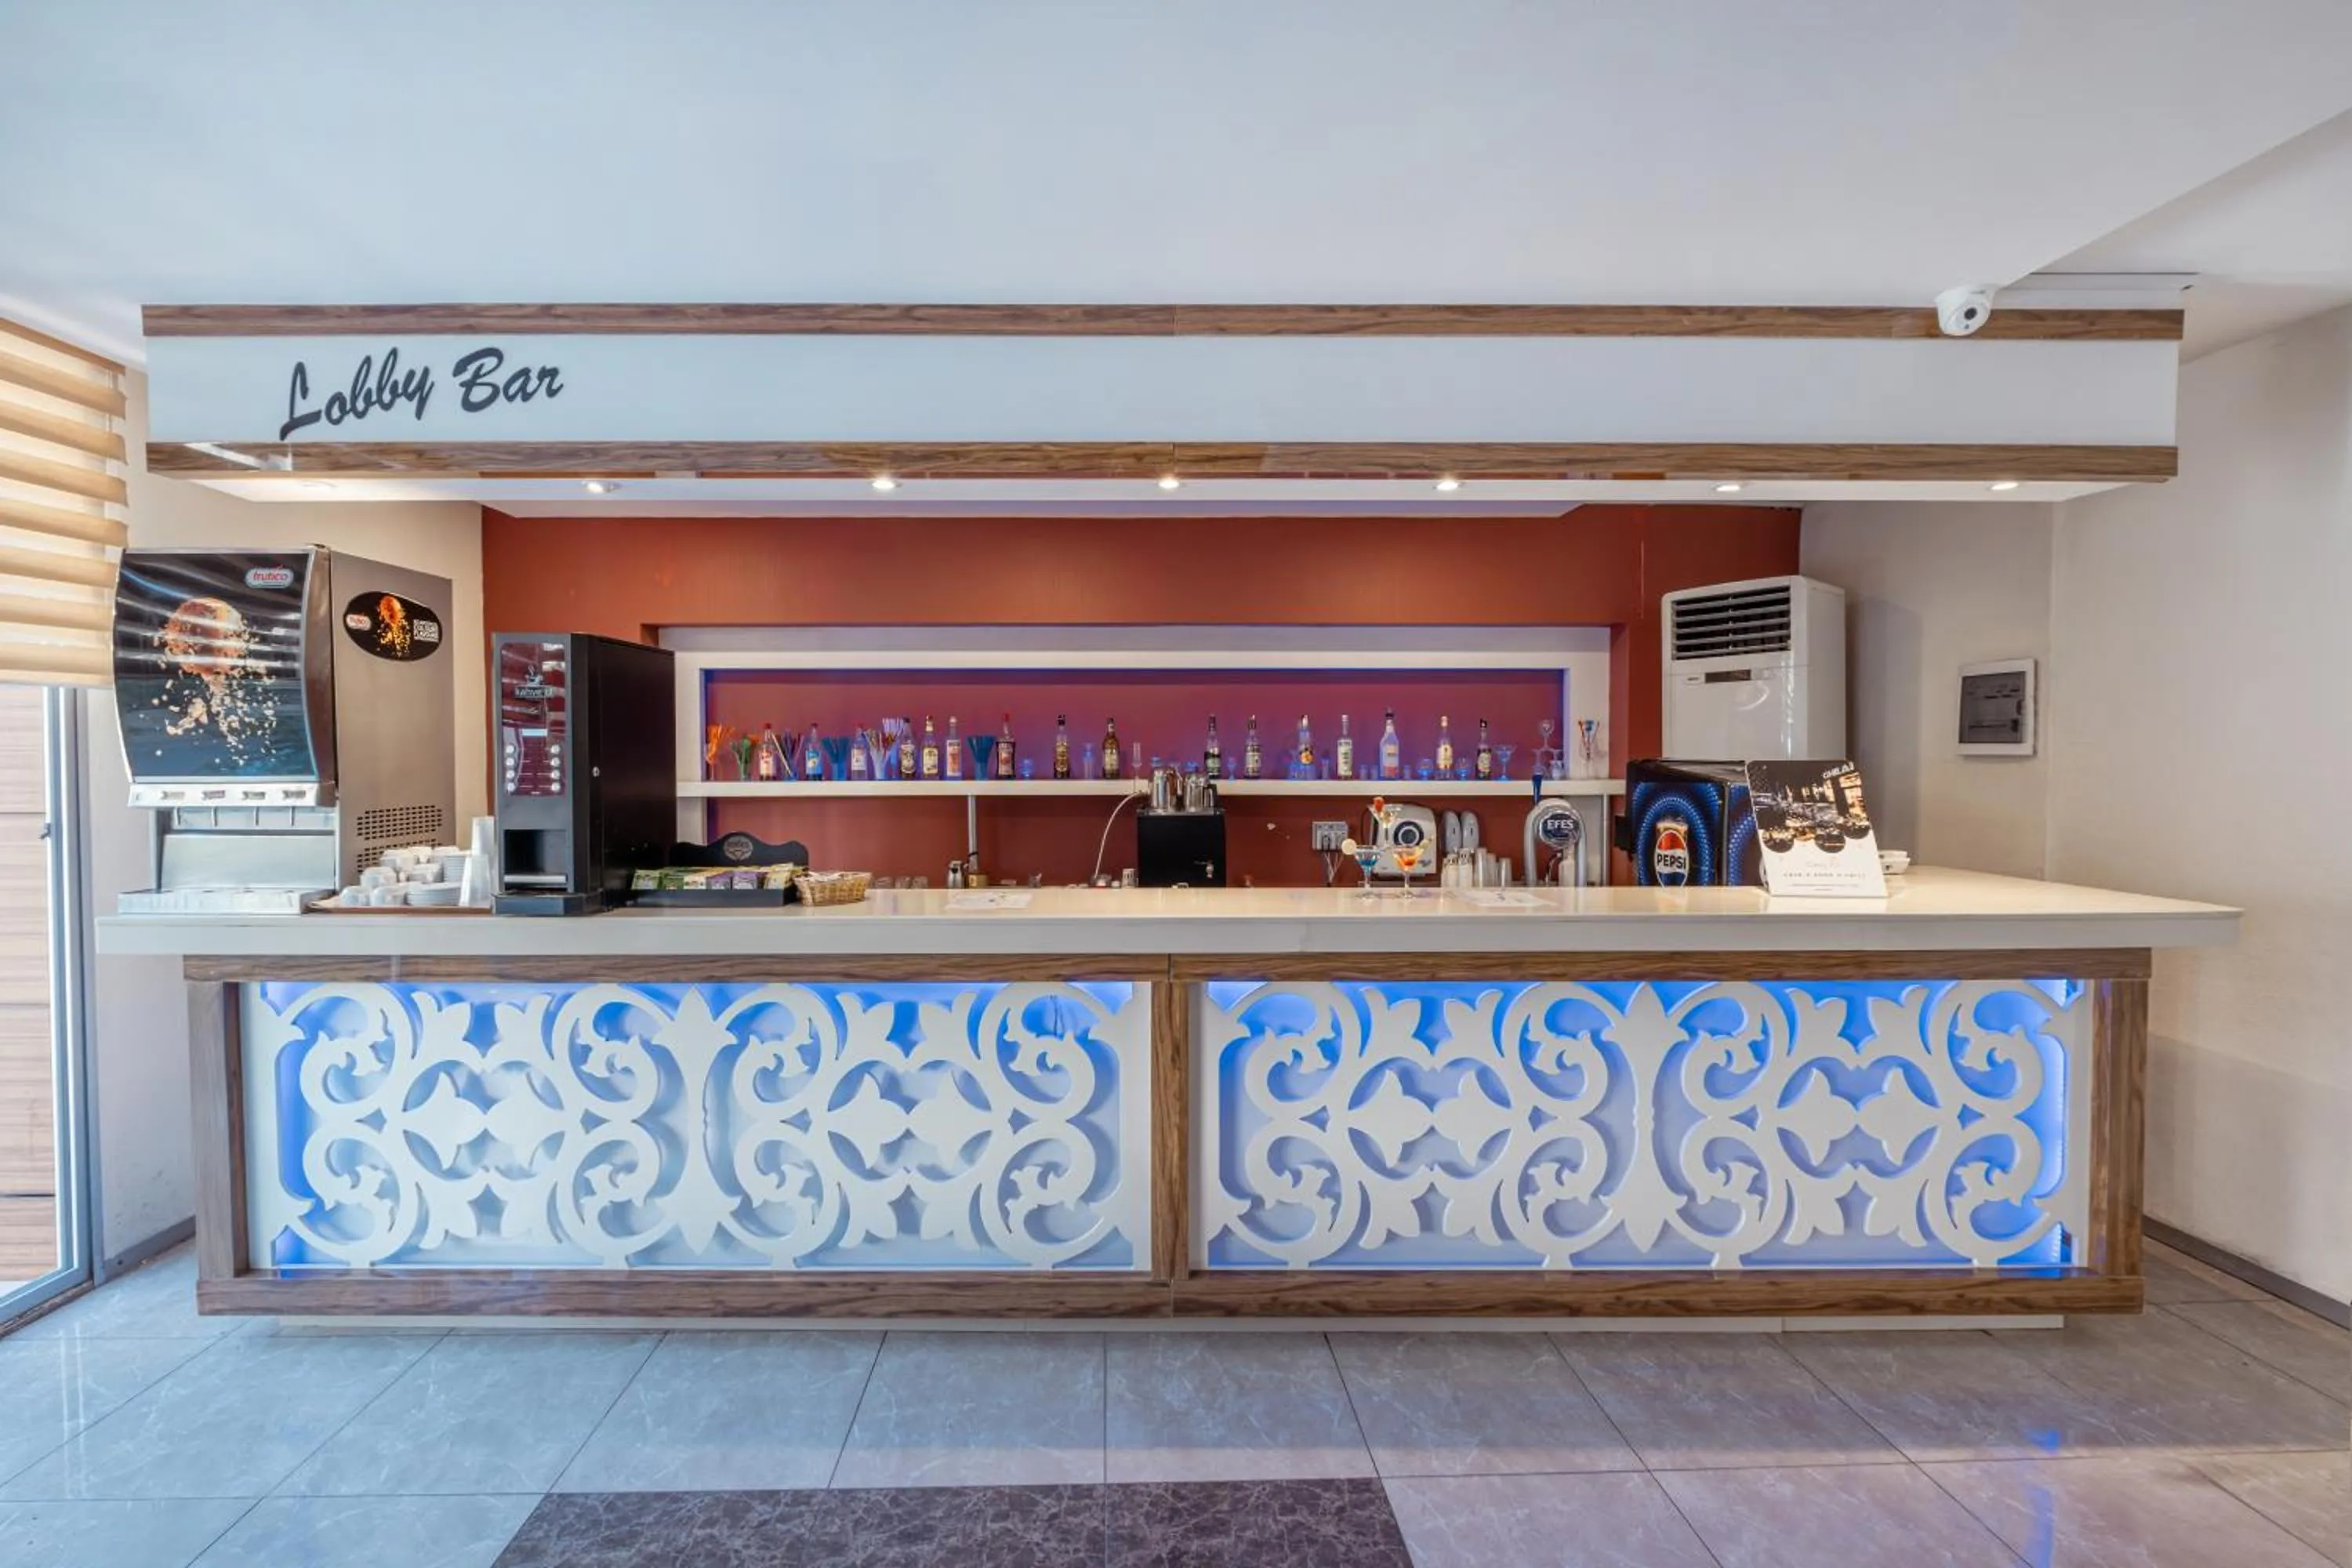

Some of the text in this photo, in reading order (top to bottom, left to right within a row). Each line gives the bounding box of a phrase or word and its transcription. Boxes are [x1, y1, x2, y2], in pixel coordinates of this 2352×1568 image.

[279, 347, 564, 441] Lobby Bar
[1547, 819, 1573, 829] EFES
[1657, 854, 1686, 869] PEPSI
